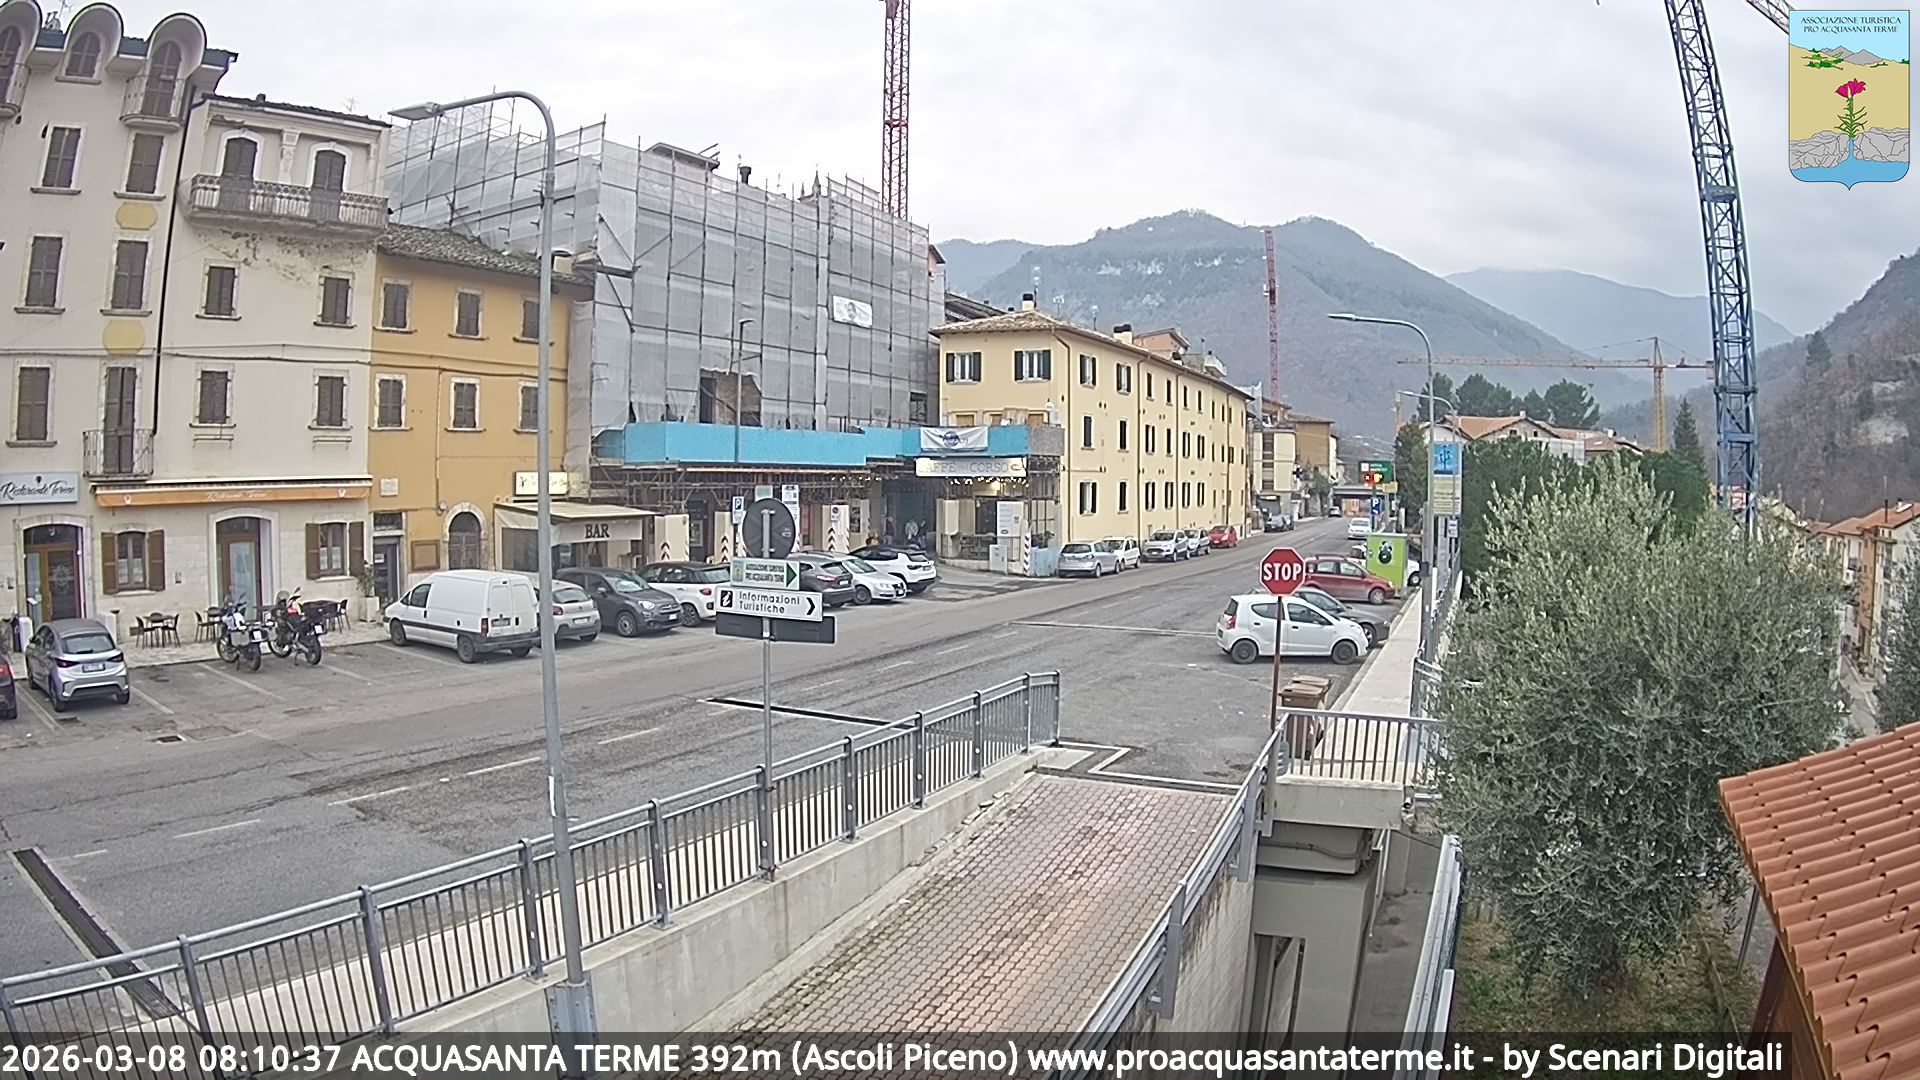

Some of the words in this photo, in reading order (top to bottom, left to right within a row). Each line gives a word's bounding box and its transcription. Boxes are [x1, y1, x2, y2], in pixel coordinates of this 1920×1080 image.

[969, 462, 1009, 473] CORSO
[585, 523, 610, 539] BAR
[1263, 562, 1302, 581] STOP
[739, 590, 800, 605] Informazioni
[739, 600, 785, 614] Turistiche
